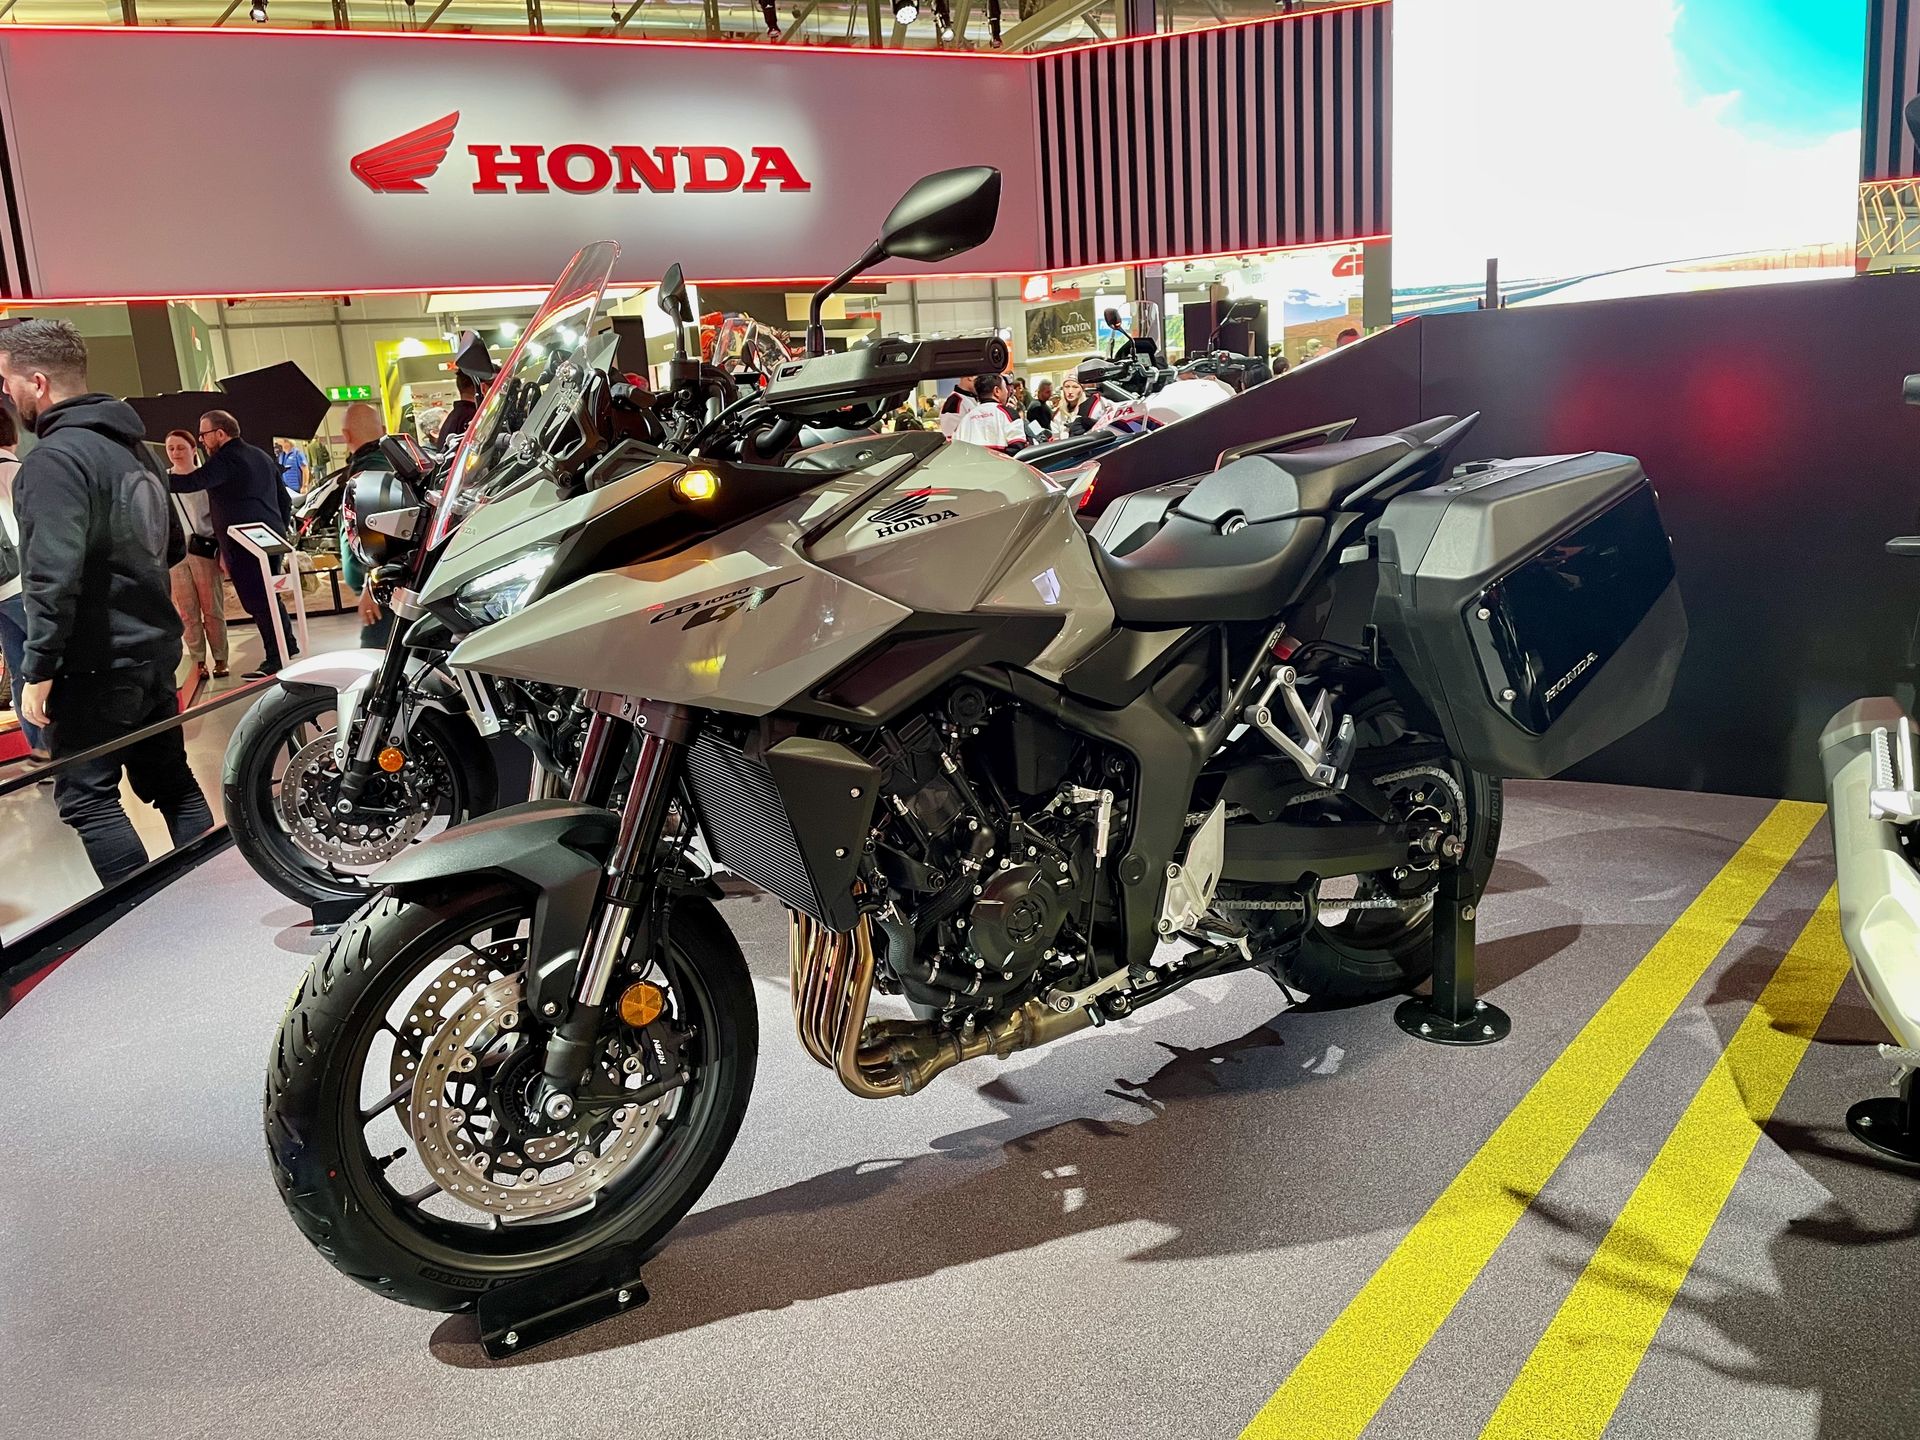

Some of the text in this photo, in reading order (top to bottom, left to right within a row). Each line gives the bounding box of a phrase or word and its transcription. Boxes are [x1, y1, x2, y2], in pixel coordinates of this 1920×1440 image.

[468, 143, 811, 194] HONDA
[1061, 322, 1091, 334] CANYON
[875, 509, 959, 538] HONDA
[681, 576, 805, 631] GT
[1545, 652, 1598, 702] HONDA
[450, 1278, 484, 1289] ROAD
